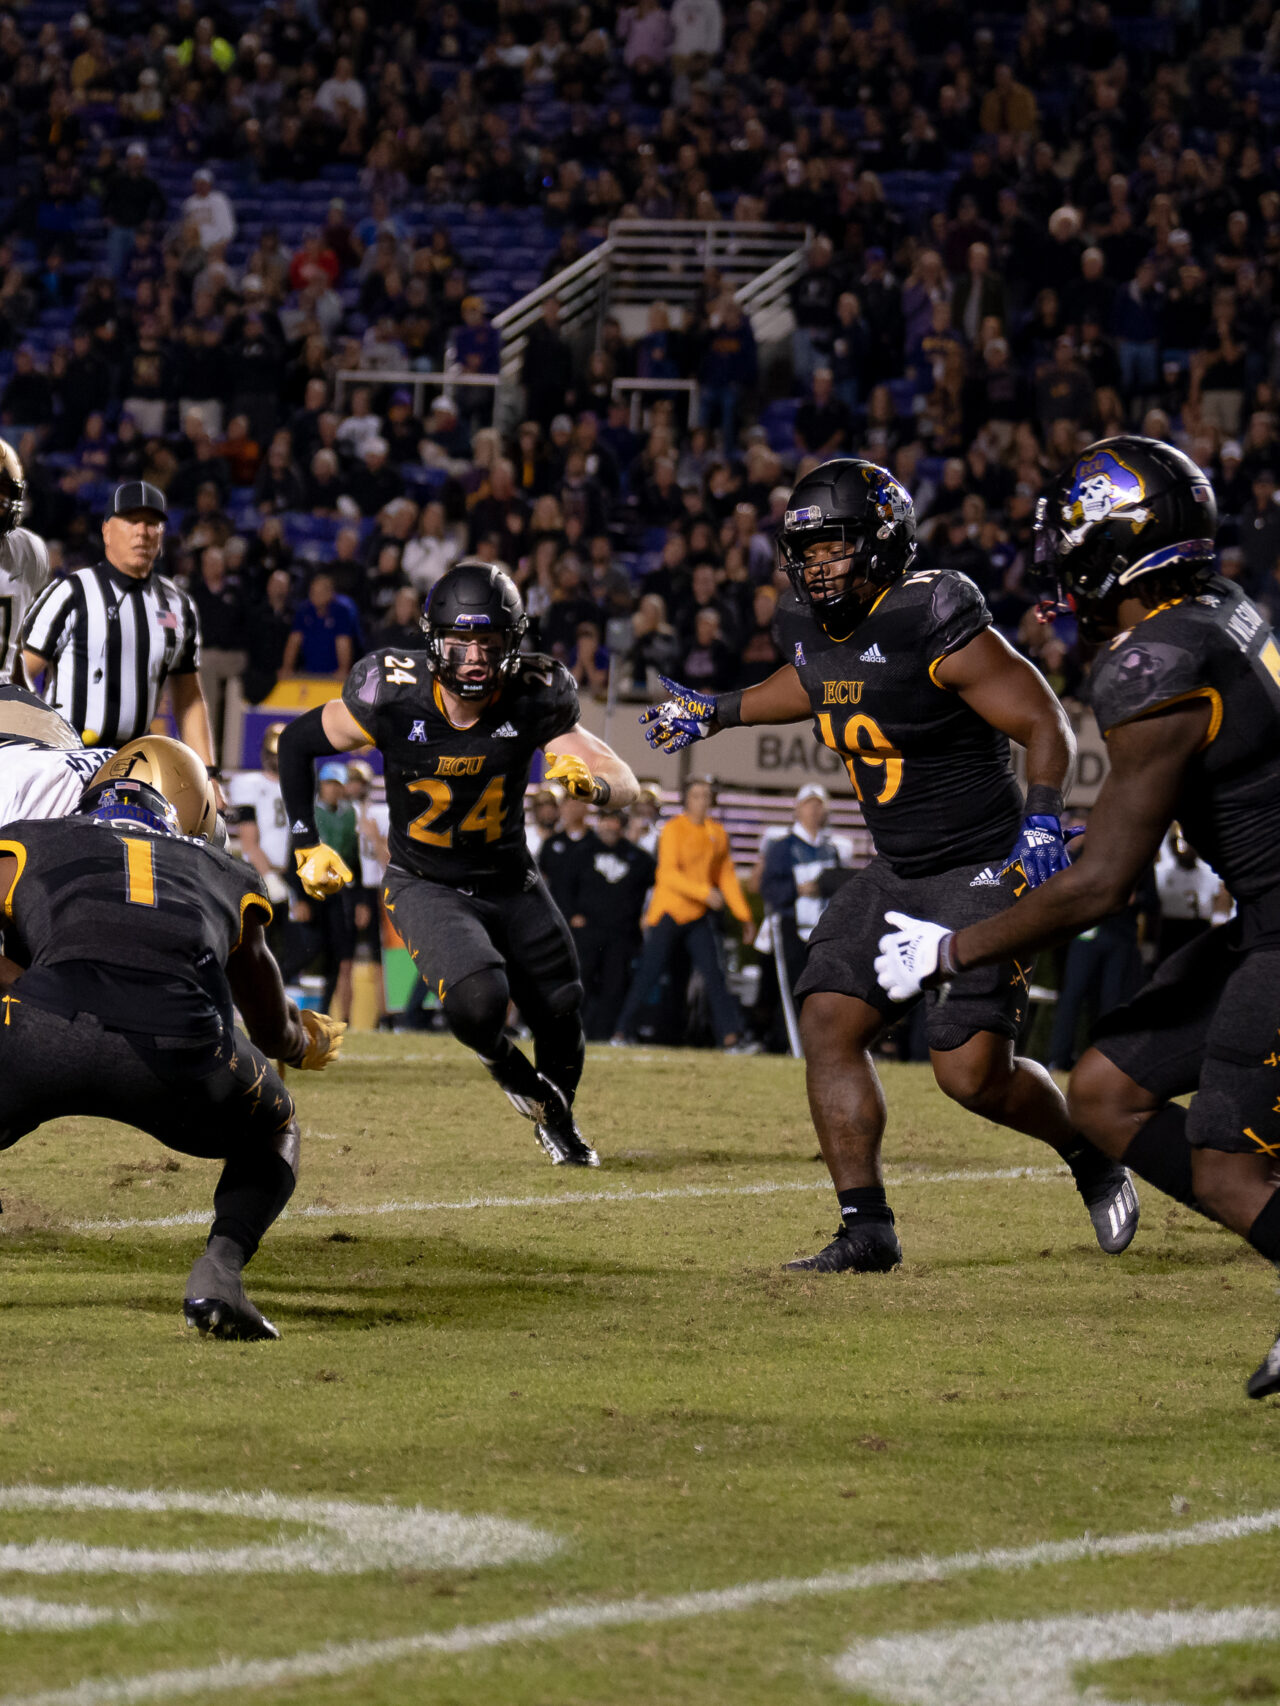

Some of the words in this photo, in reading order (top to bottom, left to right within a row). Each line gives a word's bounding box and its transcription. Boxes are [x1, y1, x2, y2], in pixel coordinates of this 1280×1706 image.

[384, 655, 418, 686] 24
[859, 654, 887, 664] adidas
[822, 680, 865, 705] ECU
[491, 730, 518, 739] adidas
[433, 755, 486, 776] ECU
[817, 712, 906, 804] 19
[407, 774, 508, 848] 24
[1023, 829, 1056, 843] adidas
[118, 835, 158, 908] 1
[969, 878, 1000, 887] adidas
